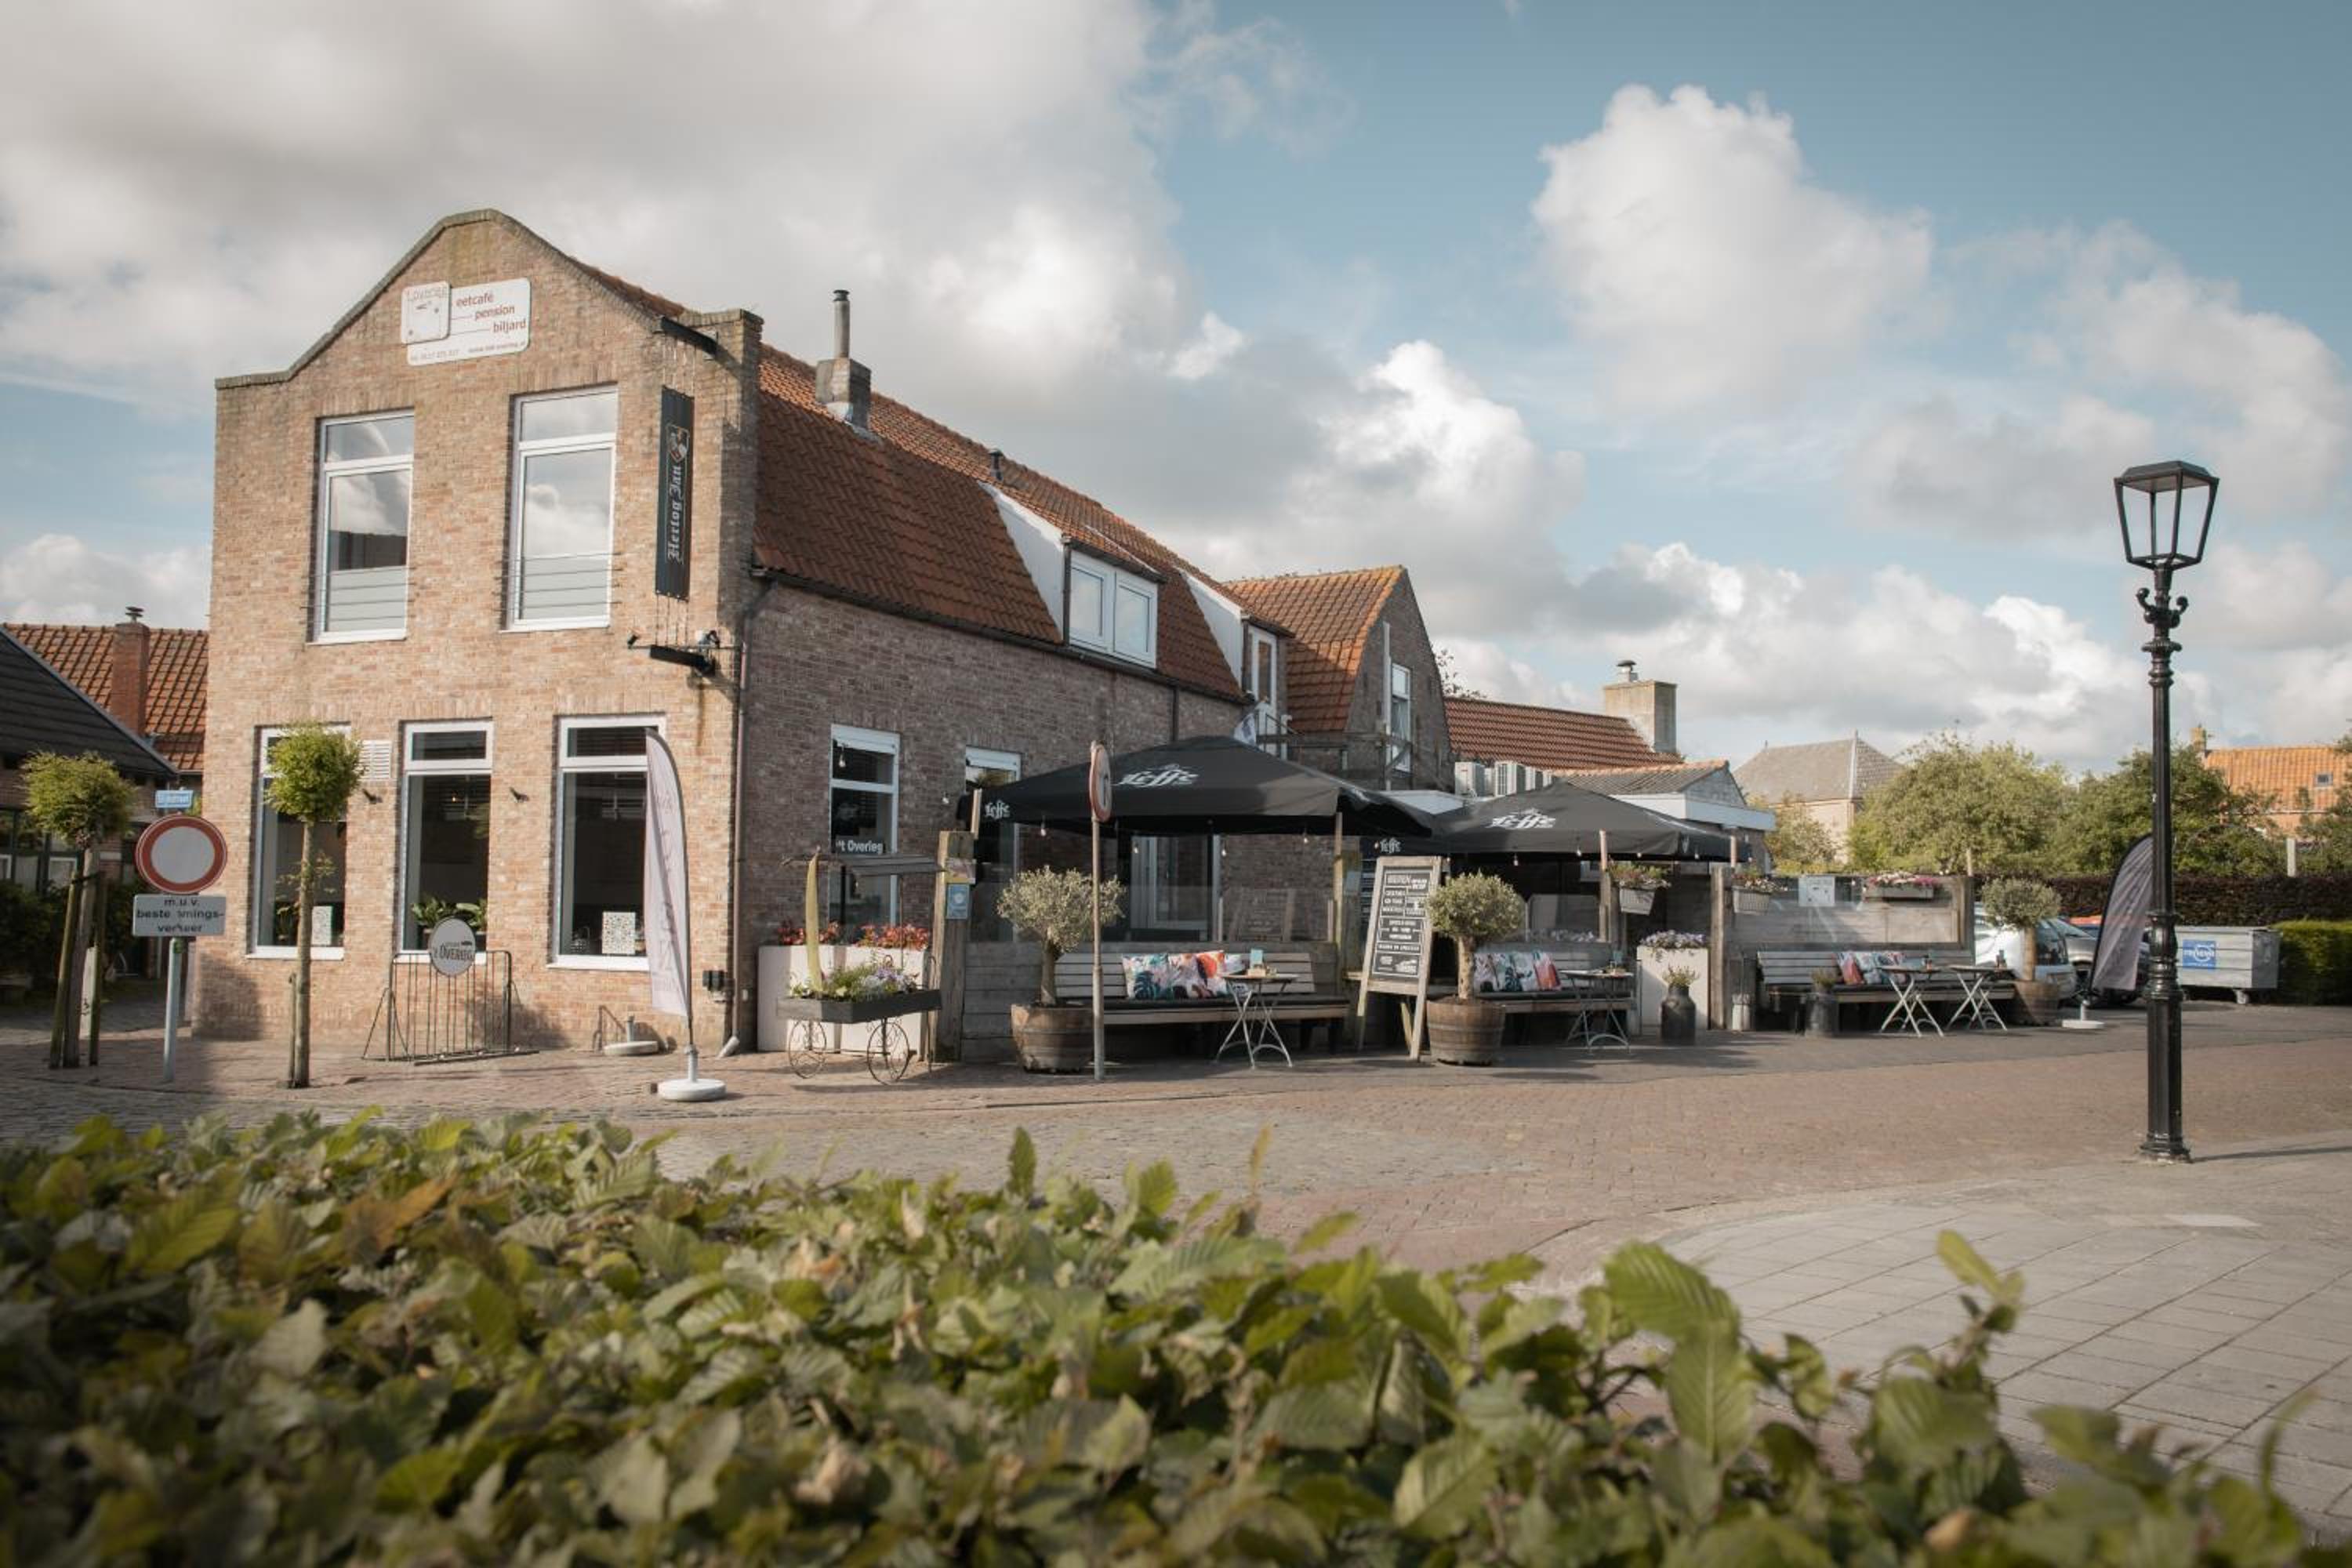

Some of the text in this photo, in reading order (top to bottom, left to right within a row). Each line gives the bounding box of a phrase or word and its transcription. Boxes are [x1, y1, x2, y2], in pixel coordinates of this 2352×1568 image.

[456, 292, 495, 307] eetcafé
[474, 304, 516, 321] pension
[493, 319, 527, 334] biljard
[667, 465, 684, 565] Hertog Jan
[848, 840, 884, 855] Overleg
[164, 898, 200, 906] m.u.v.
